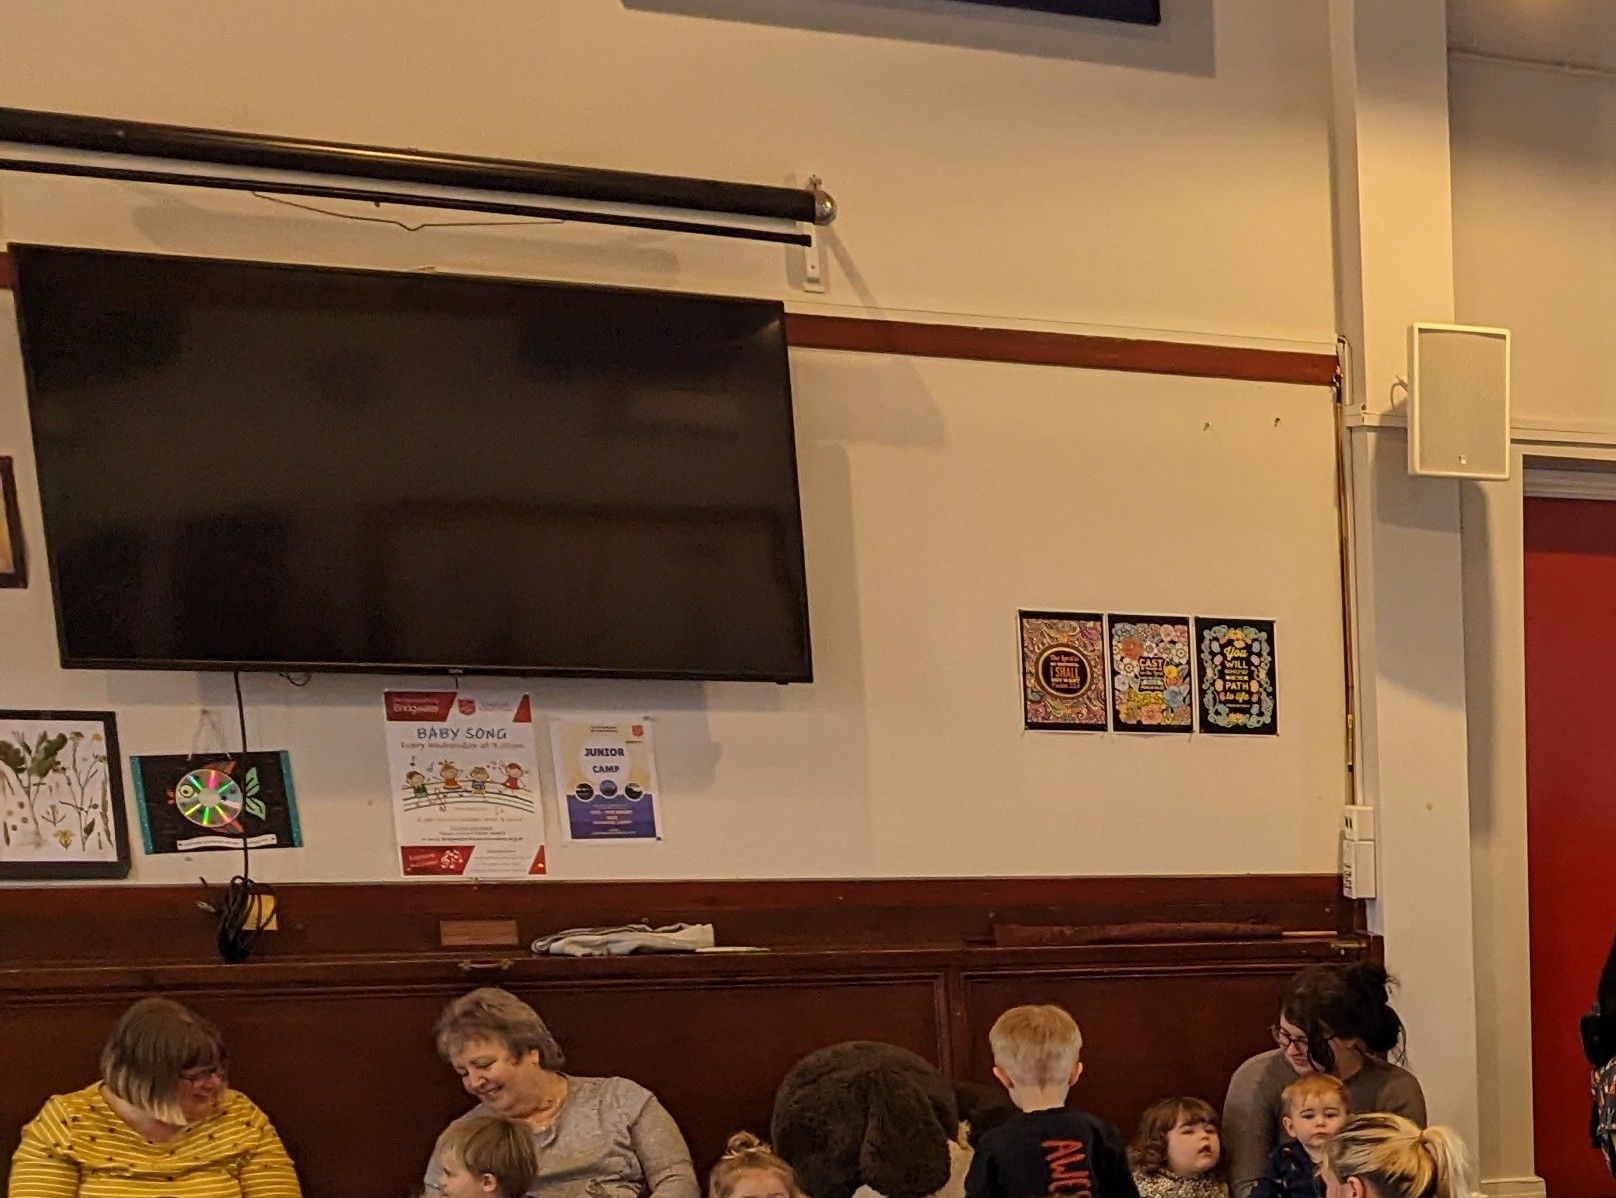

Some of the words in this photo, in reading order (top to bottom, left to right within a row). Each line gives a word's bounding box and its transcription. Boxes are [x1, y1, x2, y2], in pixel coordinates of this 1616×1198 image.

[1224, 660, 1248, 669] WILL
[1225, 682, 1249, 691] PATH
[417, 726, 460, 741] BABY
[465, 727, 507, 740] SONG
[584, 747, 625, 757] JUNIOR
[592, 765, 620, 773] CAMP
